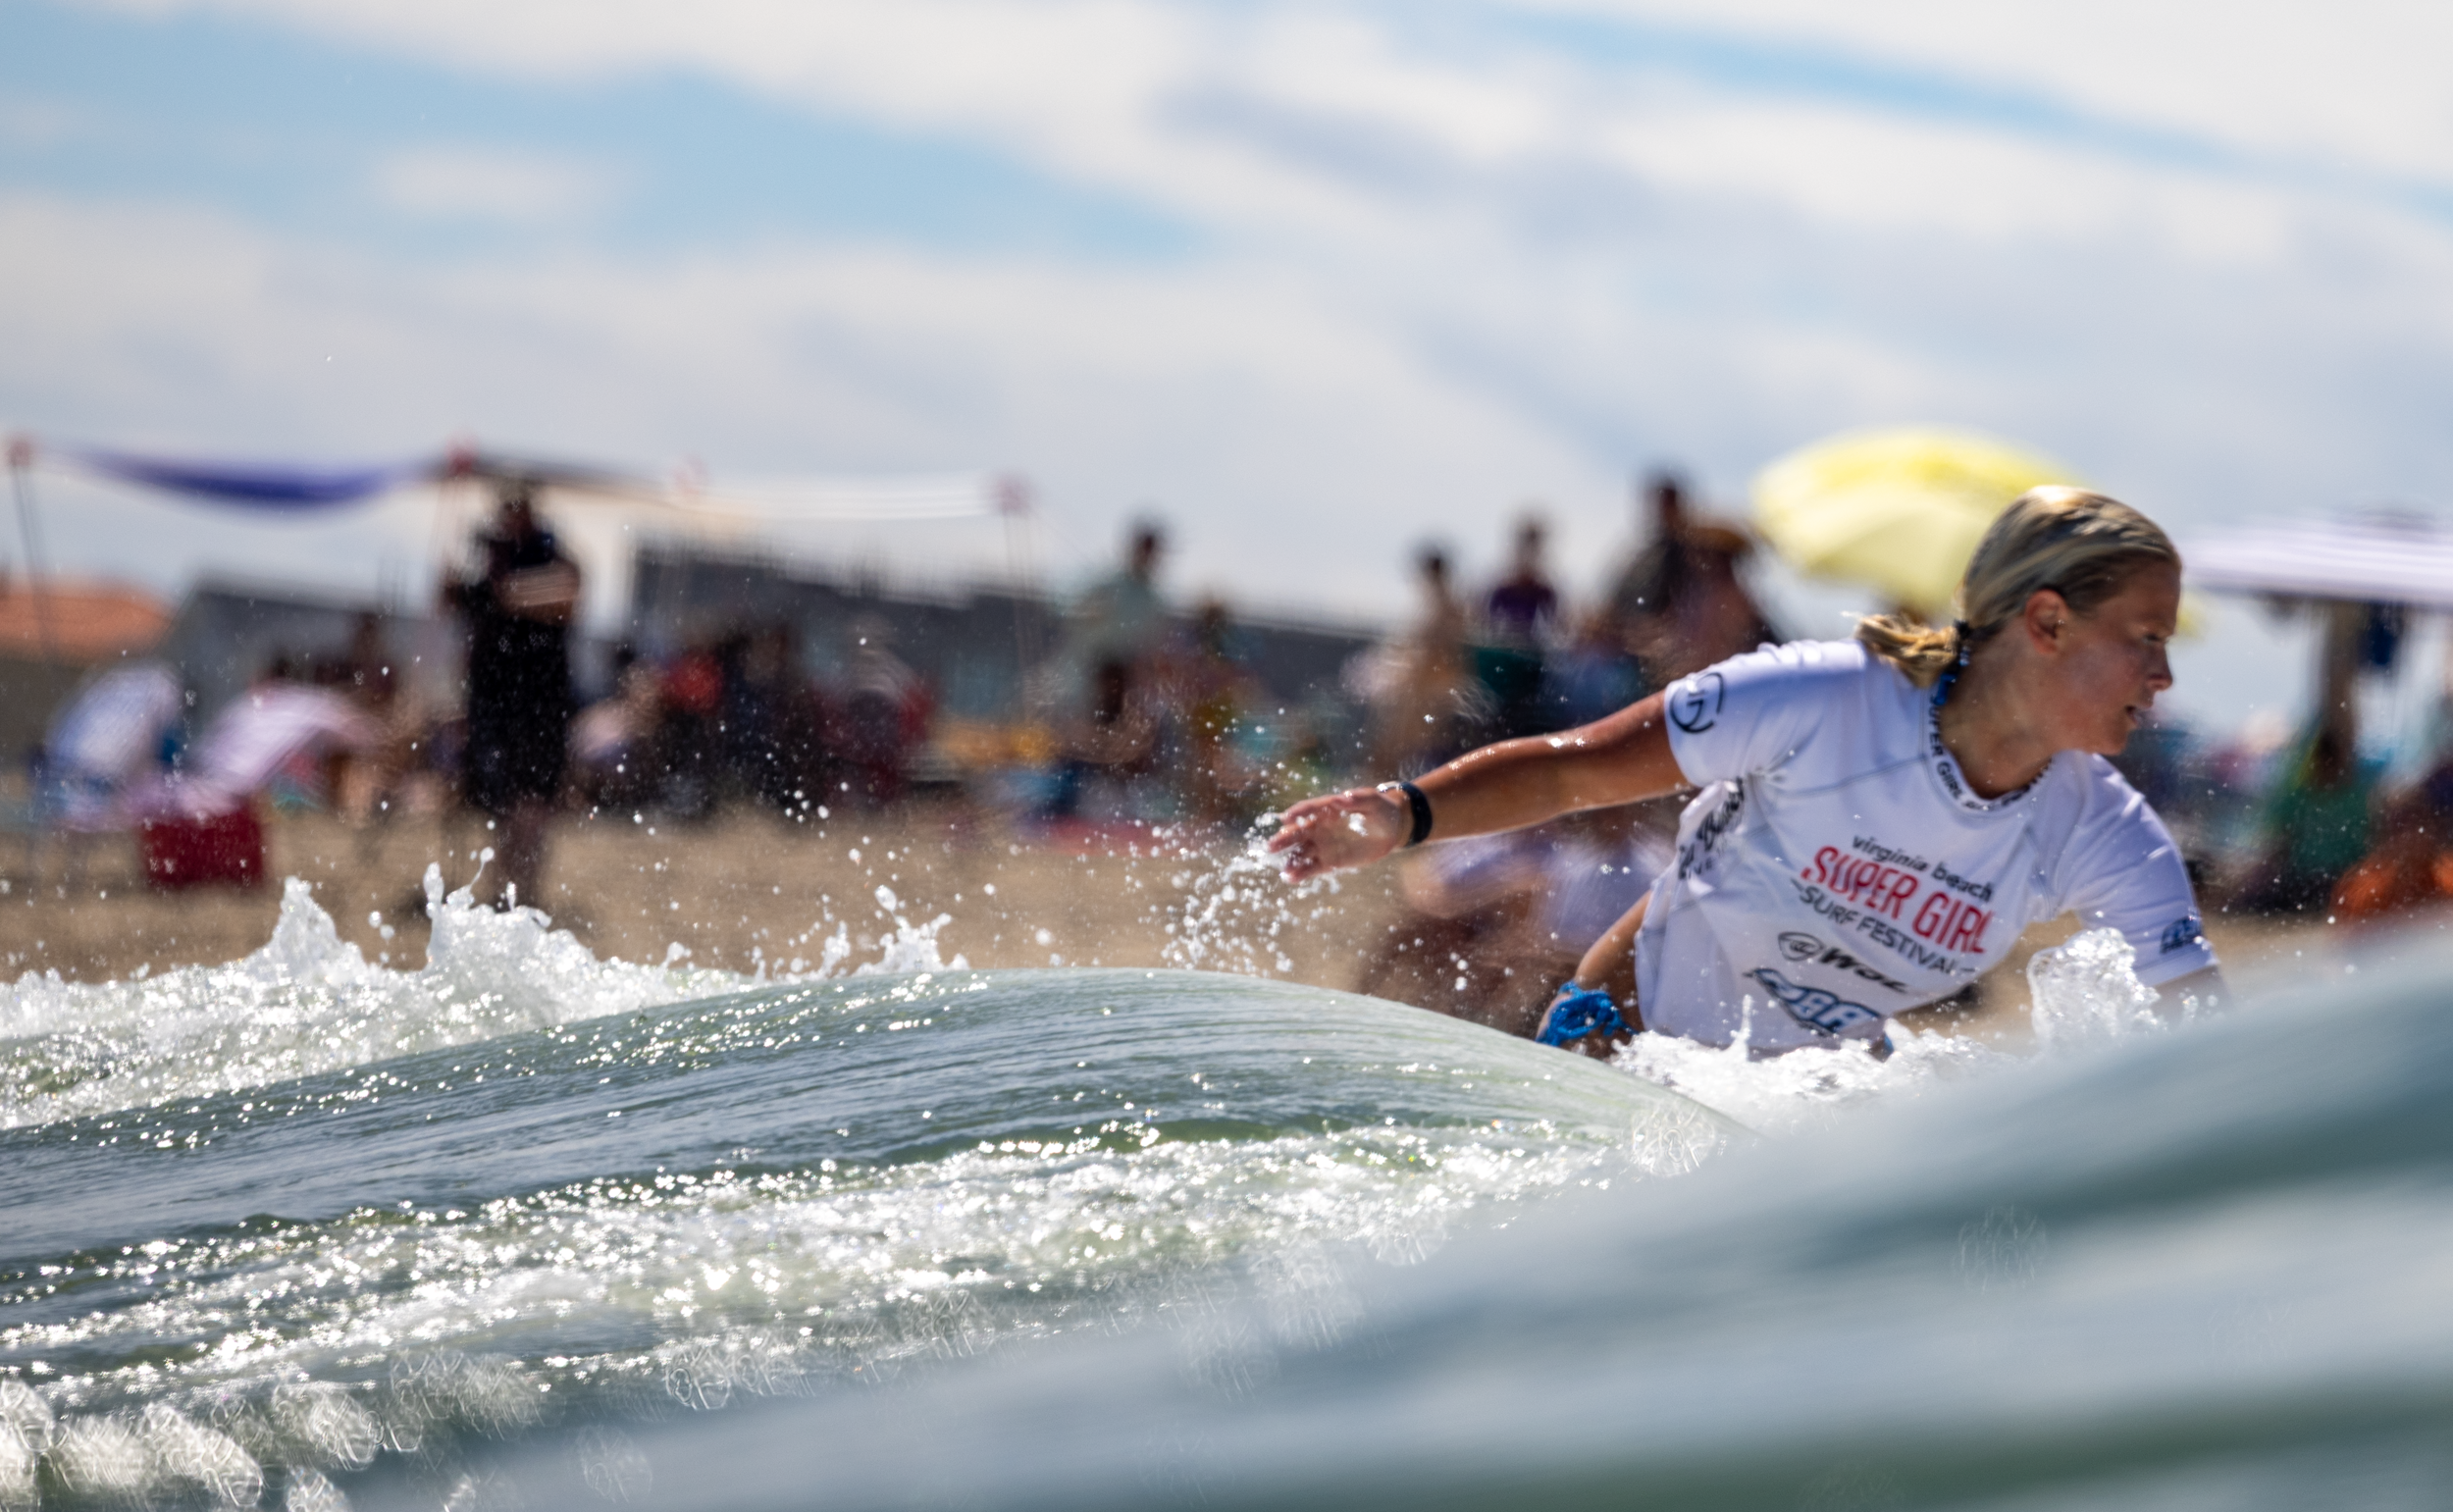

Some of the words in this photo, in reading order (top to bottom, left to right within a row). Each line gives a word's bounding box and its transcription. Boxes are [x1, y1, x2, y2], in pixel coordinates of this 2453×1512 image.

[1801, 845, 1918, 920] SUPER
[1912, 891, 1994, 955] GIRL
[1853, 835, 1929, 871] virginia
[1931, 861, 1994, 902] beach
[1799, 885, 1858, 924] SURF
[1856, 916, 1955, 975] FESTIVAL
